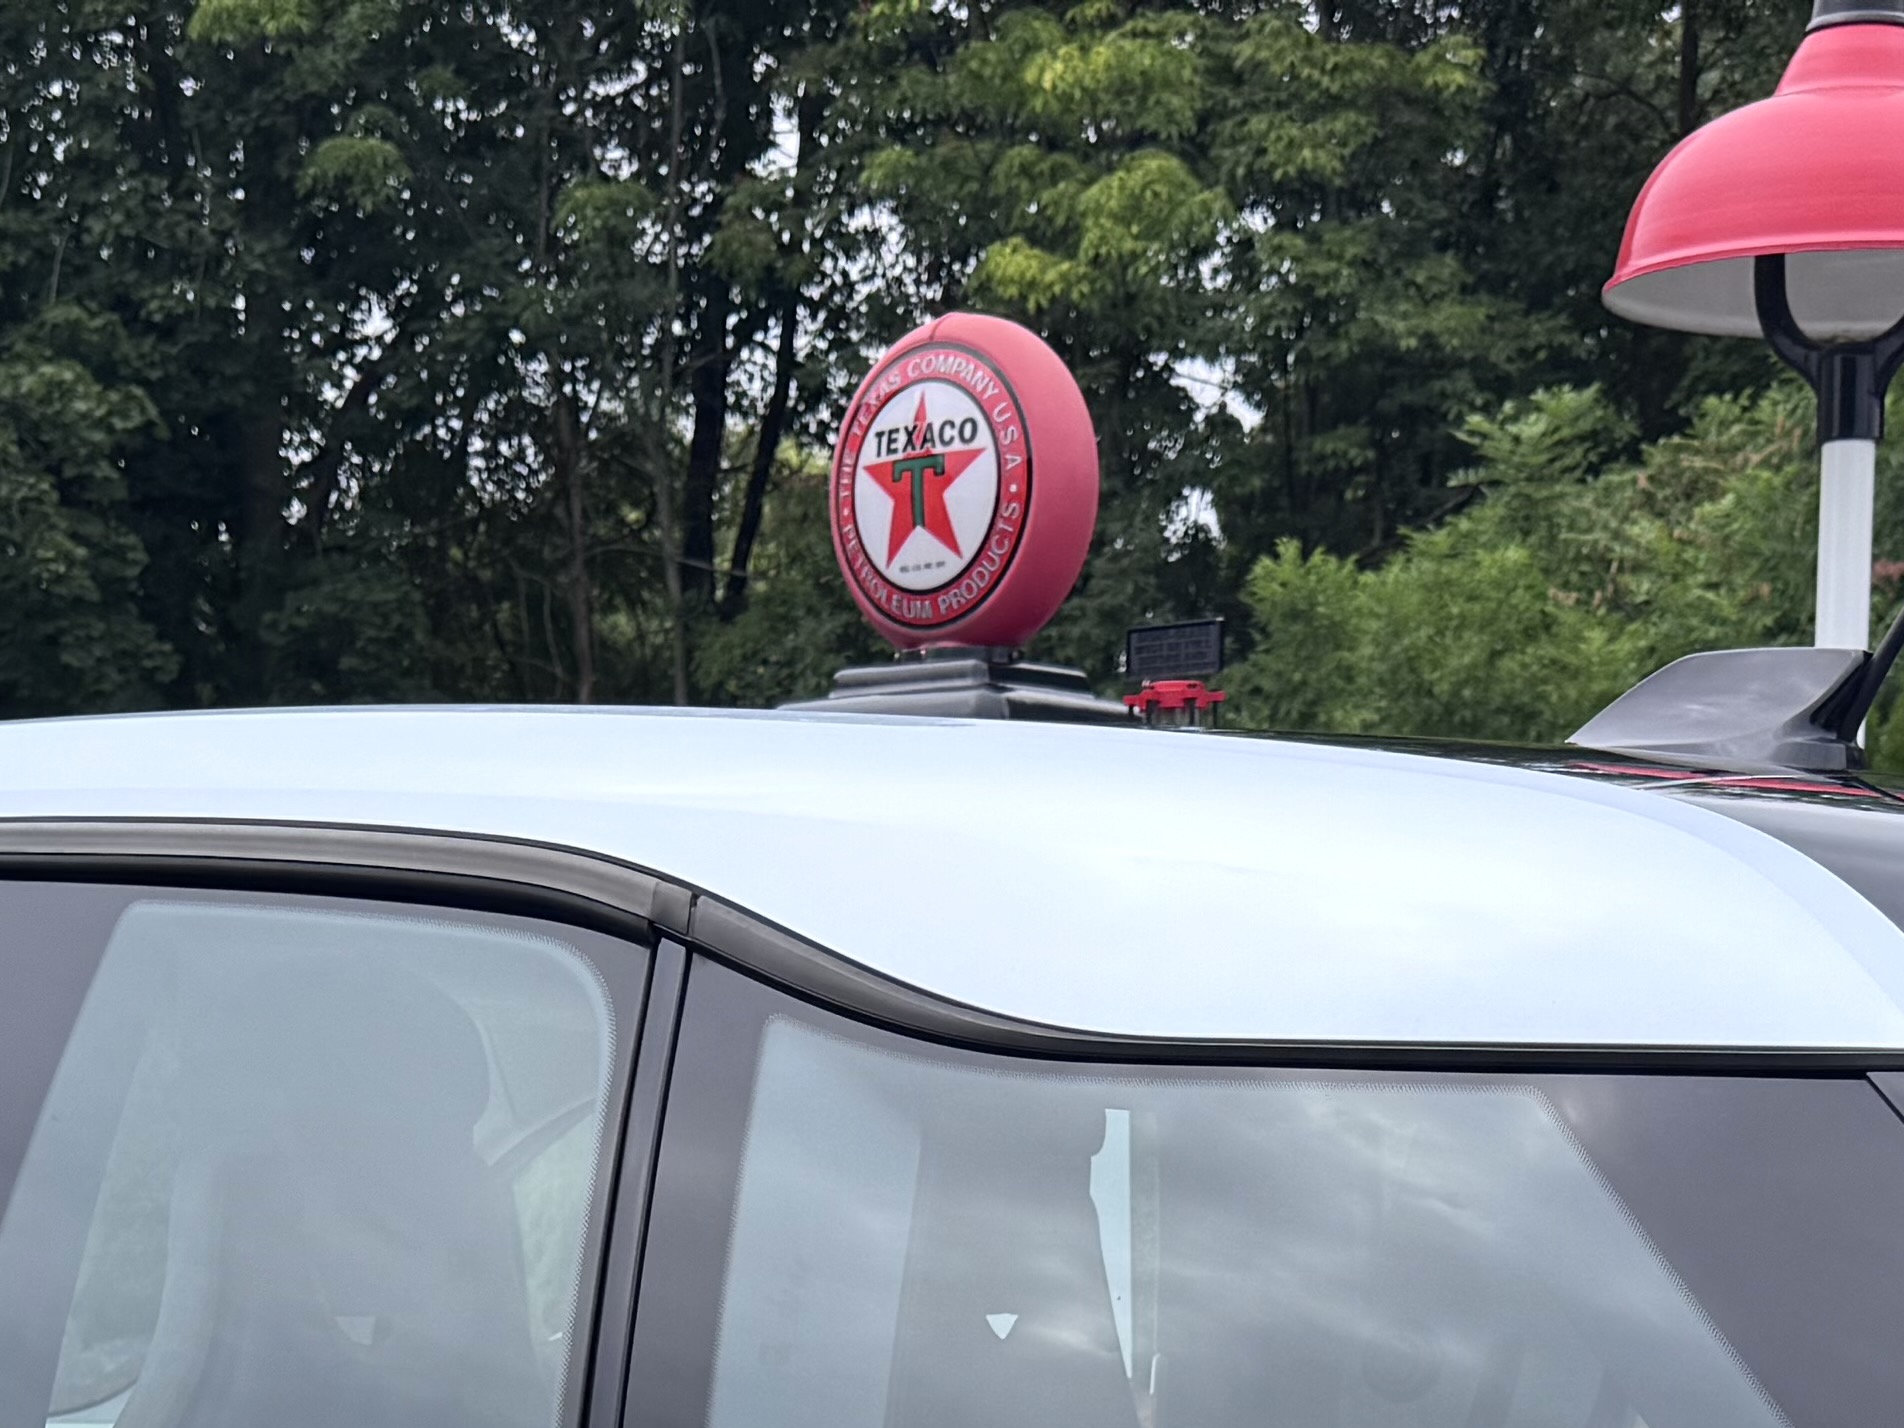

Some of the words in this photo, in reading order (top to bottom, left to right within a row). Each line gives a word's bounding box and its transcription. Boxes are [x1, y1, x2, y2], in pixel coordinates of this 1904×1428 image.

[851, 371, 901, 437] TEXAS
[907, 354, 1000, 400] COMPANY
[874, 416, 978, 458] TEXACO
[937, 502, 1020, 615] PRODUCTS
